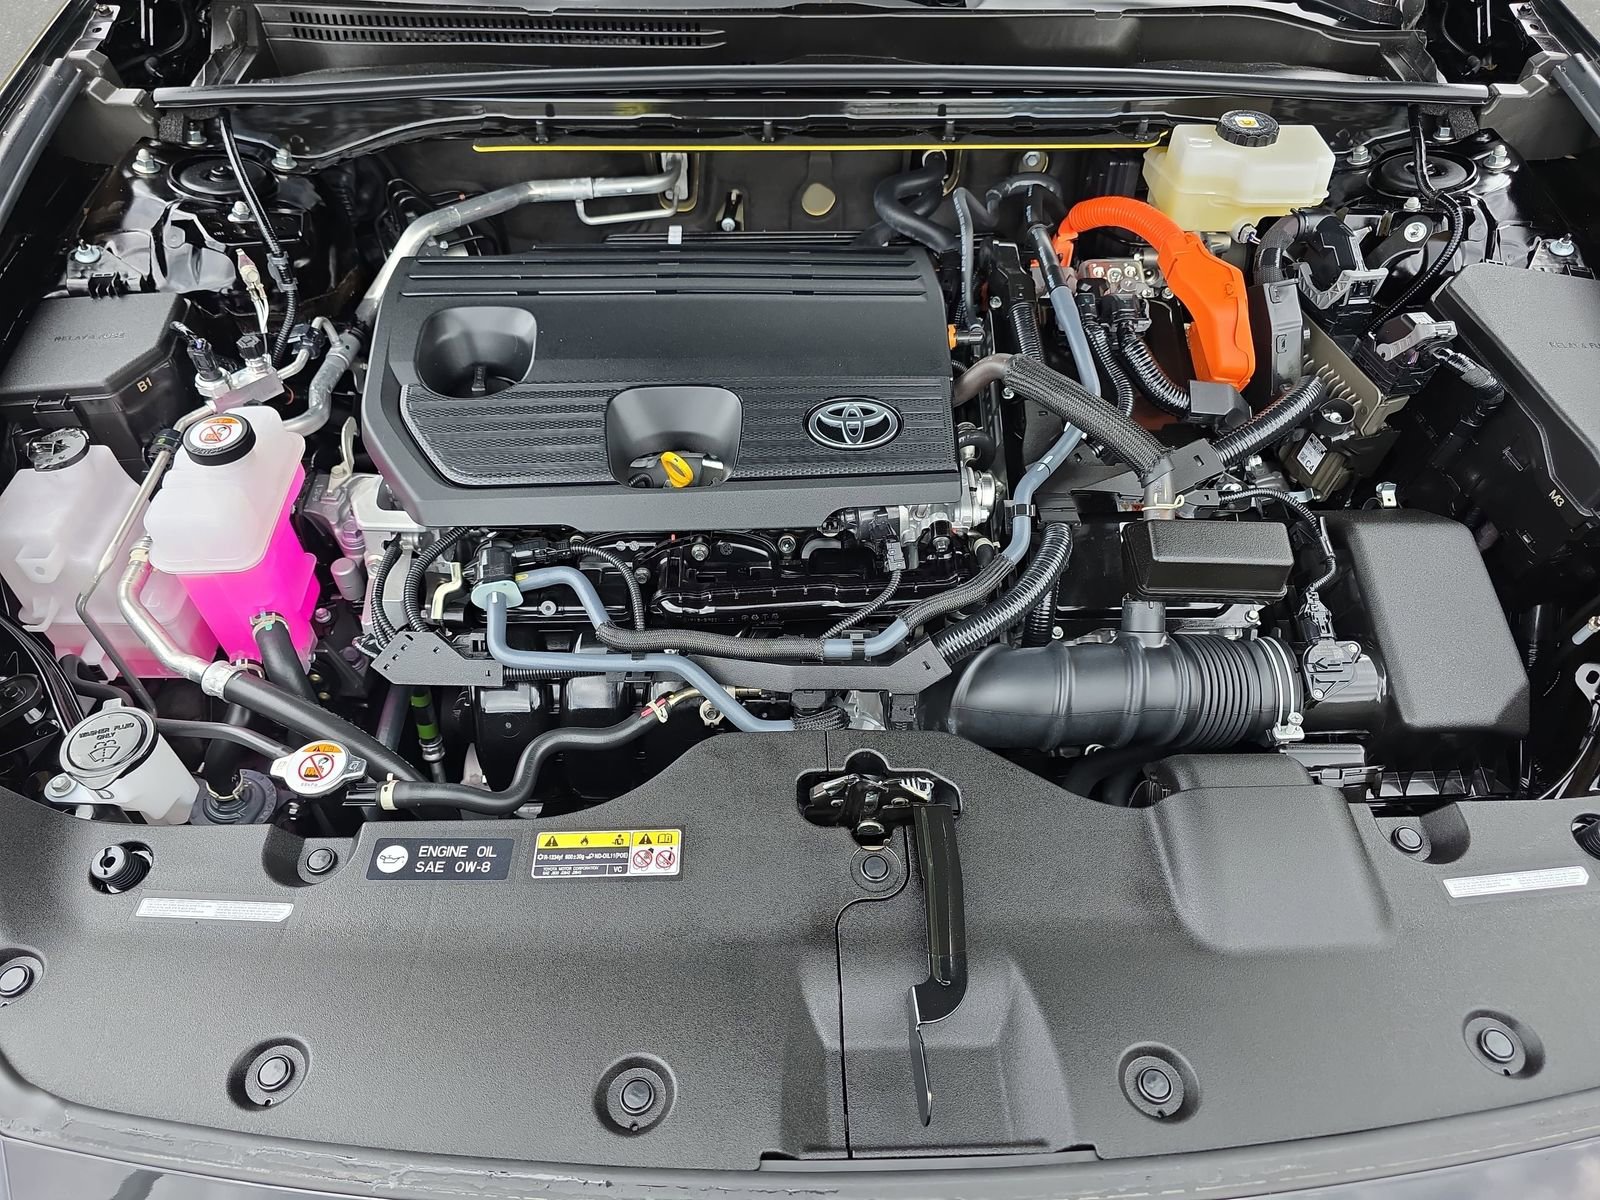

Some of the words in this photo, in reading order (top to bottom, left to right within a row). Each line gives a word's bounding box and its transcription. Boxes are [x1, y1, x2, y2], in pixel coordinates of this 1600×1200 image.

[137, 377, 153, 393] B1
[1305, 459, 1315, 472] C4
[1548, 489, 1565, 507] M3
[79, 727, 110, 738] WASHER
[113, 722, 135, 731] FLUID
[96, 731, 116, 740] ONLY
[418, 845, 468, 858] ENGINE
[476, 845, 497, 858] OIL
[414, 861, 446, 873] SAE
[454, 861, 492, 873] 0W-8
